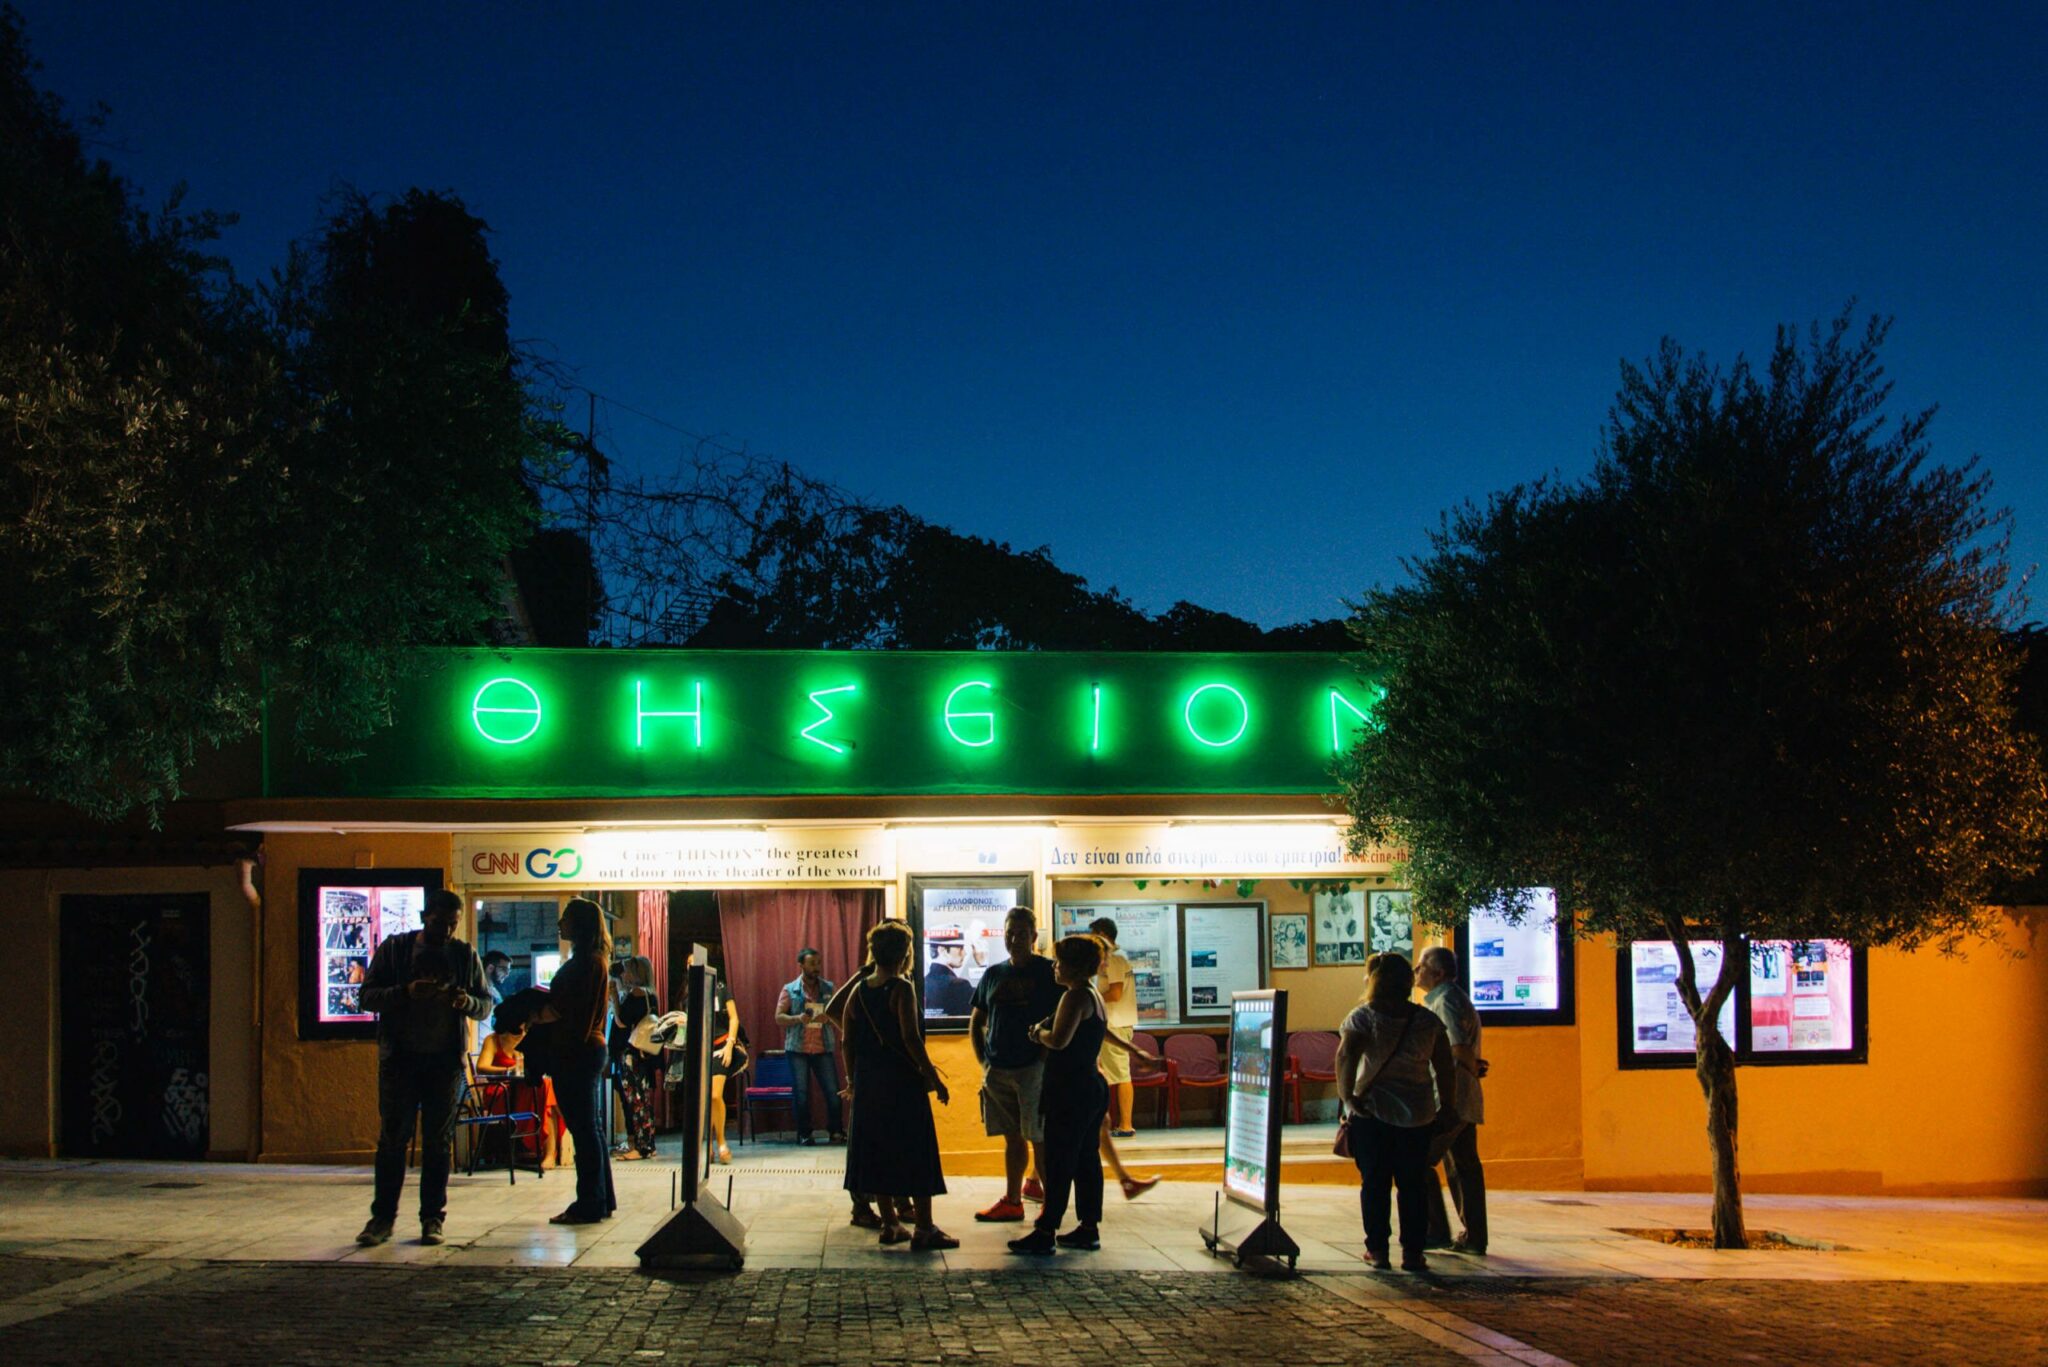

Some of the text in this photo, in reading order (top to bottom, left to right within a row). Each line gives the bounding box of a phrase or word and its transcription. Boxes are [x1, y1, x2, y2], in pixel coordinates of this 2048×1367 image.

[472, 852, 519, 875] CNN
[766, 847, 791, 860] the
[796, 848, 859, 863] greatest
[1050, 846, 1078, 865] Δεν
[1085, 846, 1120, 865] είναι
[1125, 845, 1162, 865] απλά
[599, 864, 881, 878] out door movie theater of the world
